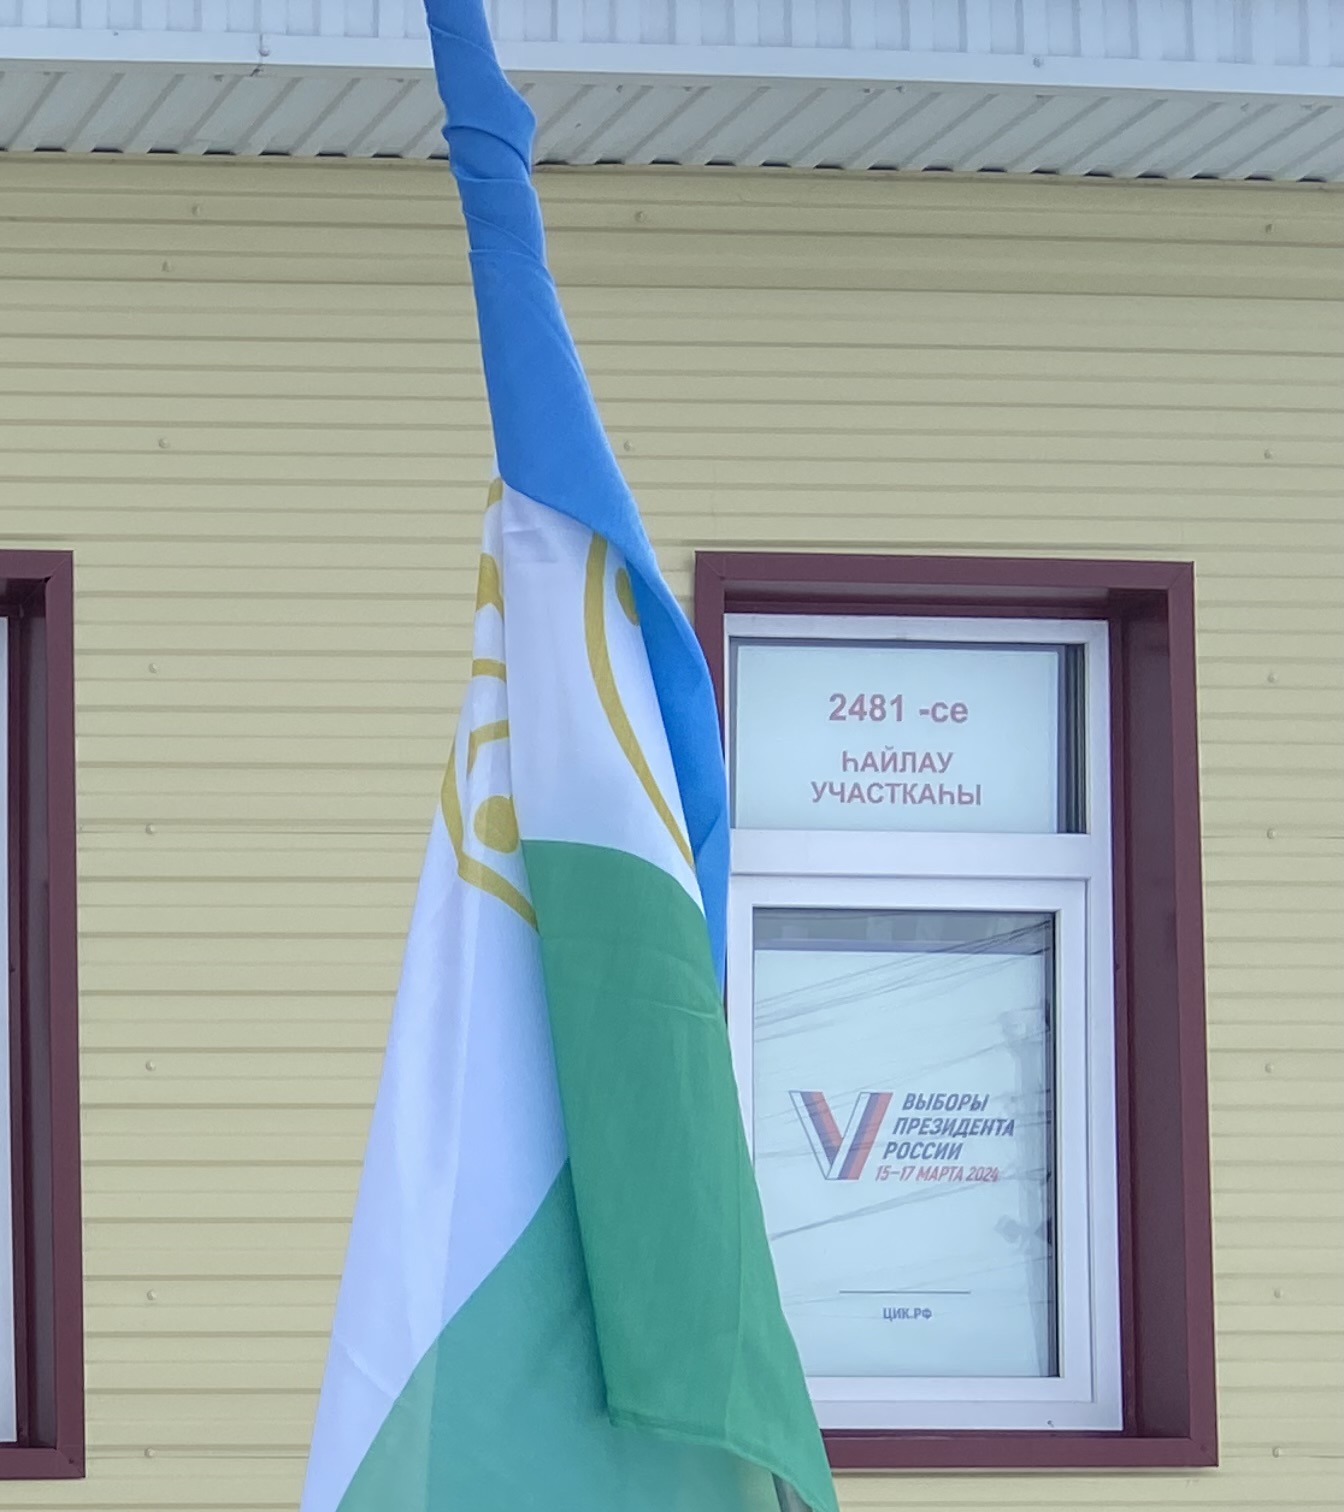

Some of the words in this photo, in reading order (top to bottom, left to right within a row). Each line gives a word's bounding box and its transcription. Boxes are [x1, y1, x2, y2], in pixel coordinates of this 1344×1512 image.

[828, 692, 903, 722] 2481
[918, 701, 969, 724] -се
[901, 1092, 991, 1112] ВЫБОРЫ
[891, 1117, 1016, 1138] ПРЕЗИДЕНТА
[882, 1141, 964, 1161] РОССИИ
[916, 1166, 965, 1182] МАРТА
[965, 1166, 1000, 1183] 2024
[882, 1307, 933, 1322] ЦИК.РФ
